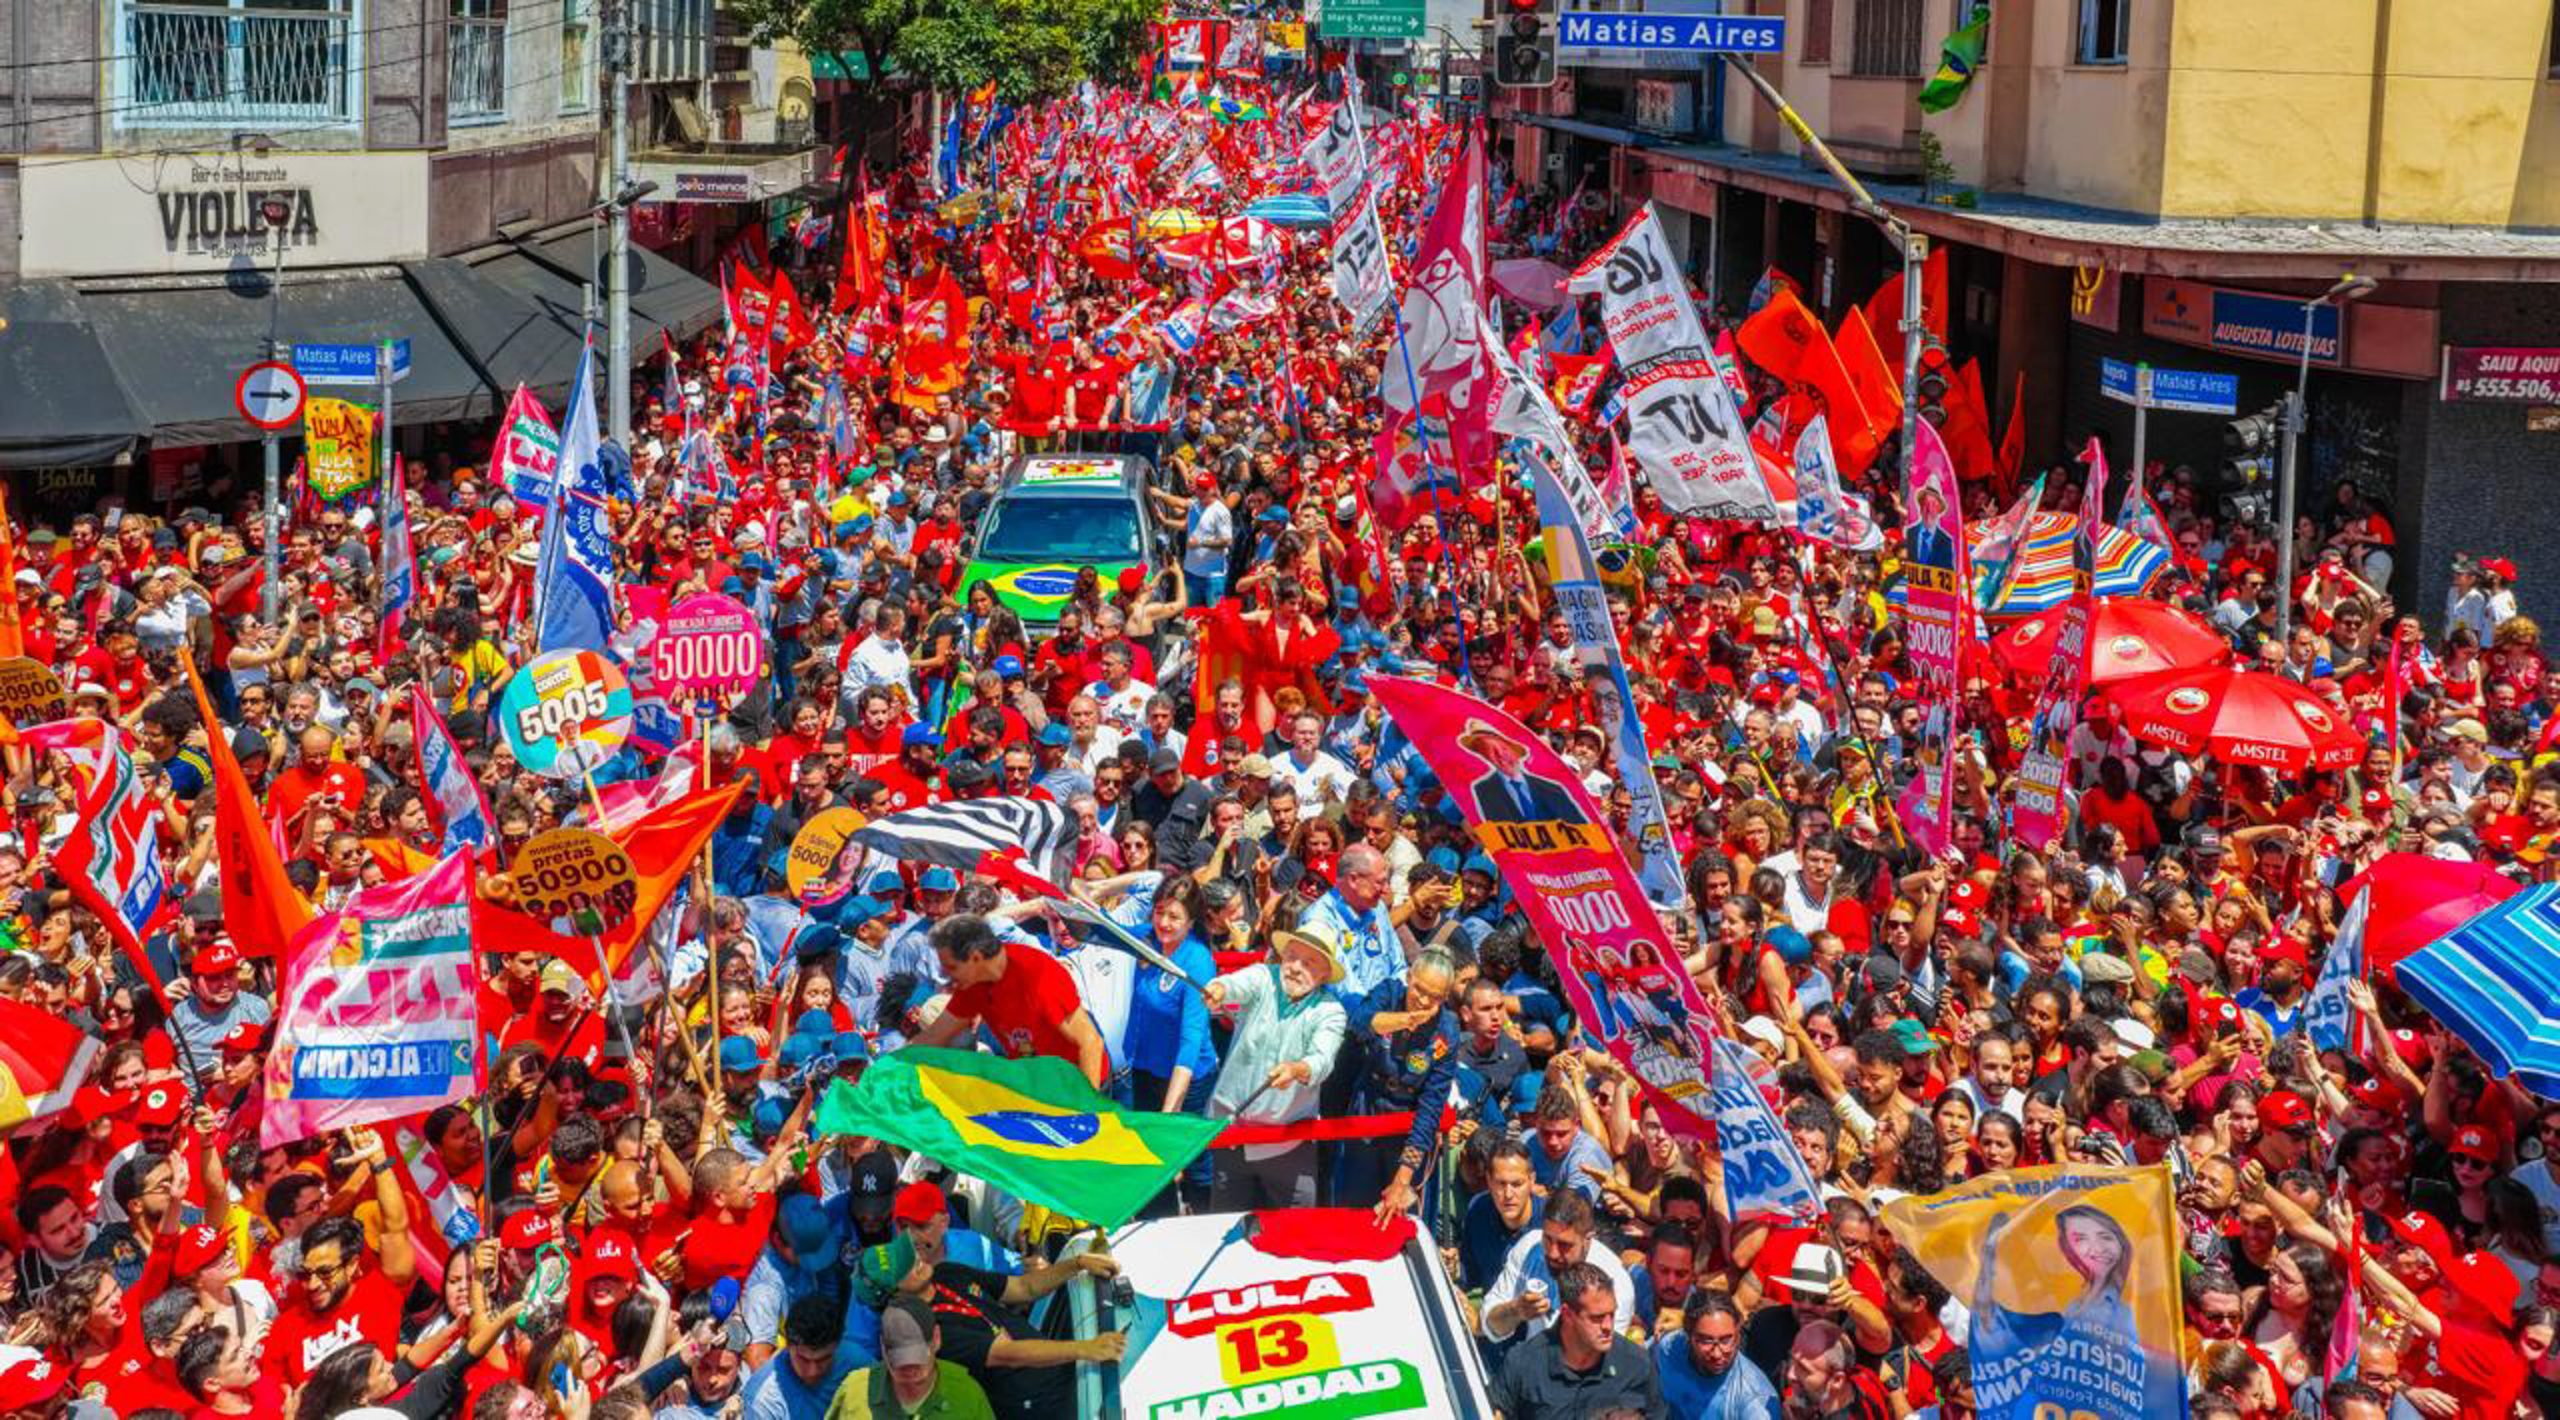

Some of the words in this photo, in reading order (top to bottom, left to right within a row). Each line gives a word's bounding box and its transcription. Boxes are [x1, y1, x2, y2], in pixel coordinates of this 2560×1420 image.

[1567, 18, 1676, 43] Matias
[1689, 22, 1776, 47] Aires
[2215, 322, 2273, 349] AUGUSTA
[296, 348, 337, 363] Matias
[340, 349, 372, 364] Aires
[2478, 354, 2519, 372] SAIU
[2520, 355, 2560, 374] AQUI
[2155, 371, 2197, 391] Matias
[2200, 377, 2232, 395] Aires
[657, 630, 757, 682] 50000
[516, 678, 608, 745] 5005
[2142, 721, 2190, 748] AMSTEL
[2230, 742, 2289, 764] AMSTEL
[531, 845, 595, 873] pretas
[515, 852, 628, 897] 50900
[1536, 888, 1632, 936] 0000
[1172, 1275, 1351, 1326] LULA
[1225, 1319, 1309, 1375] 13
[1156, 1362, 1403, 1420] HADDAD
